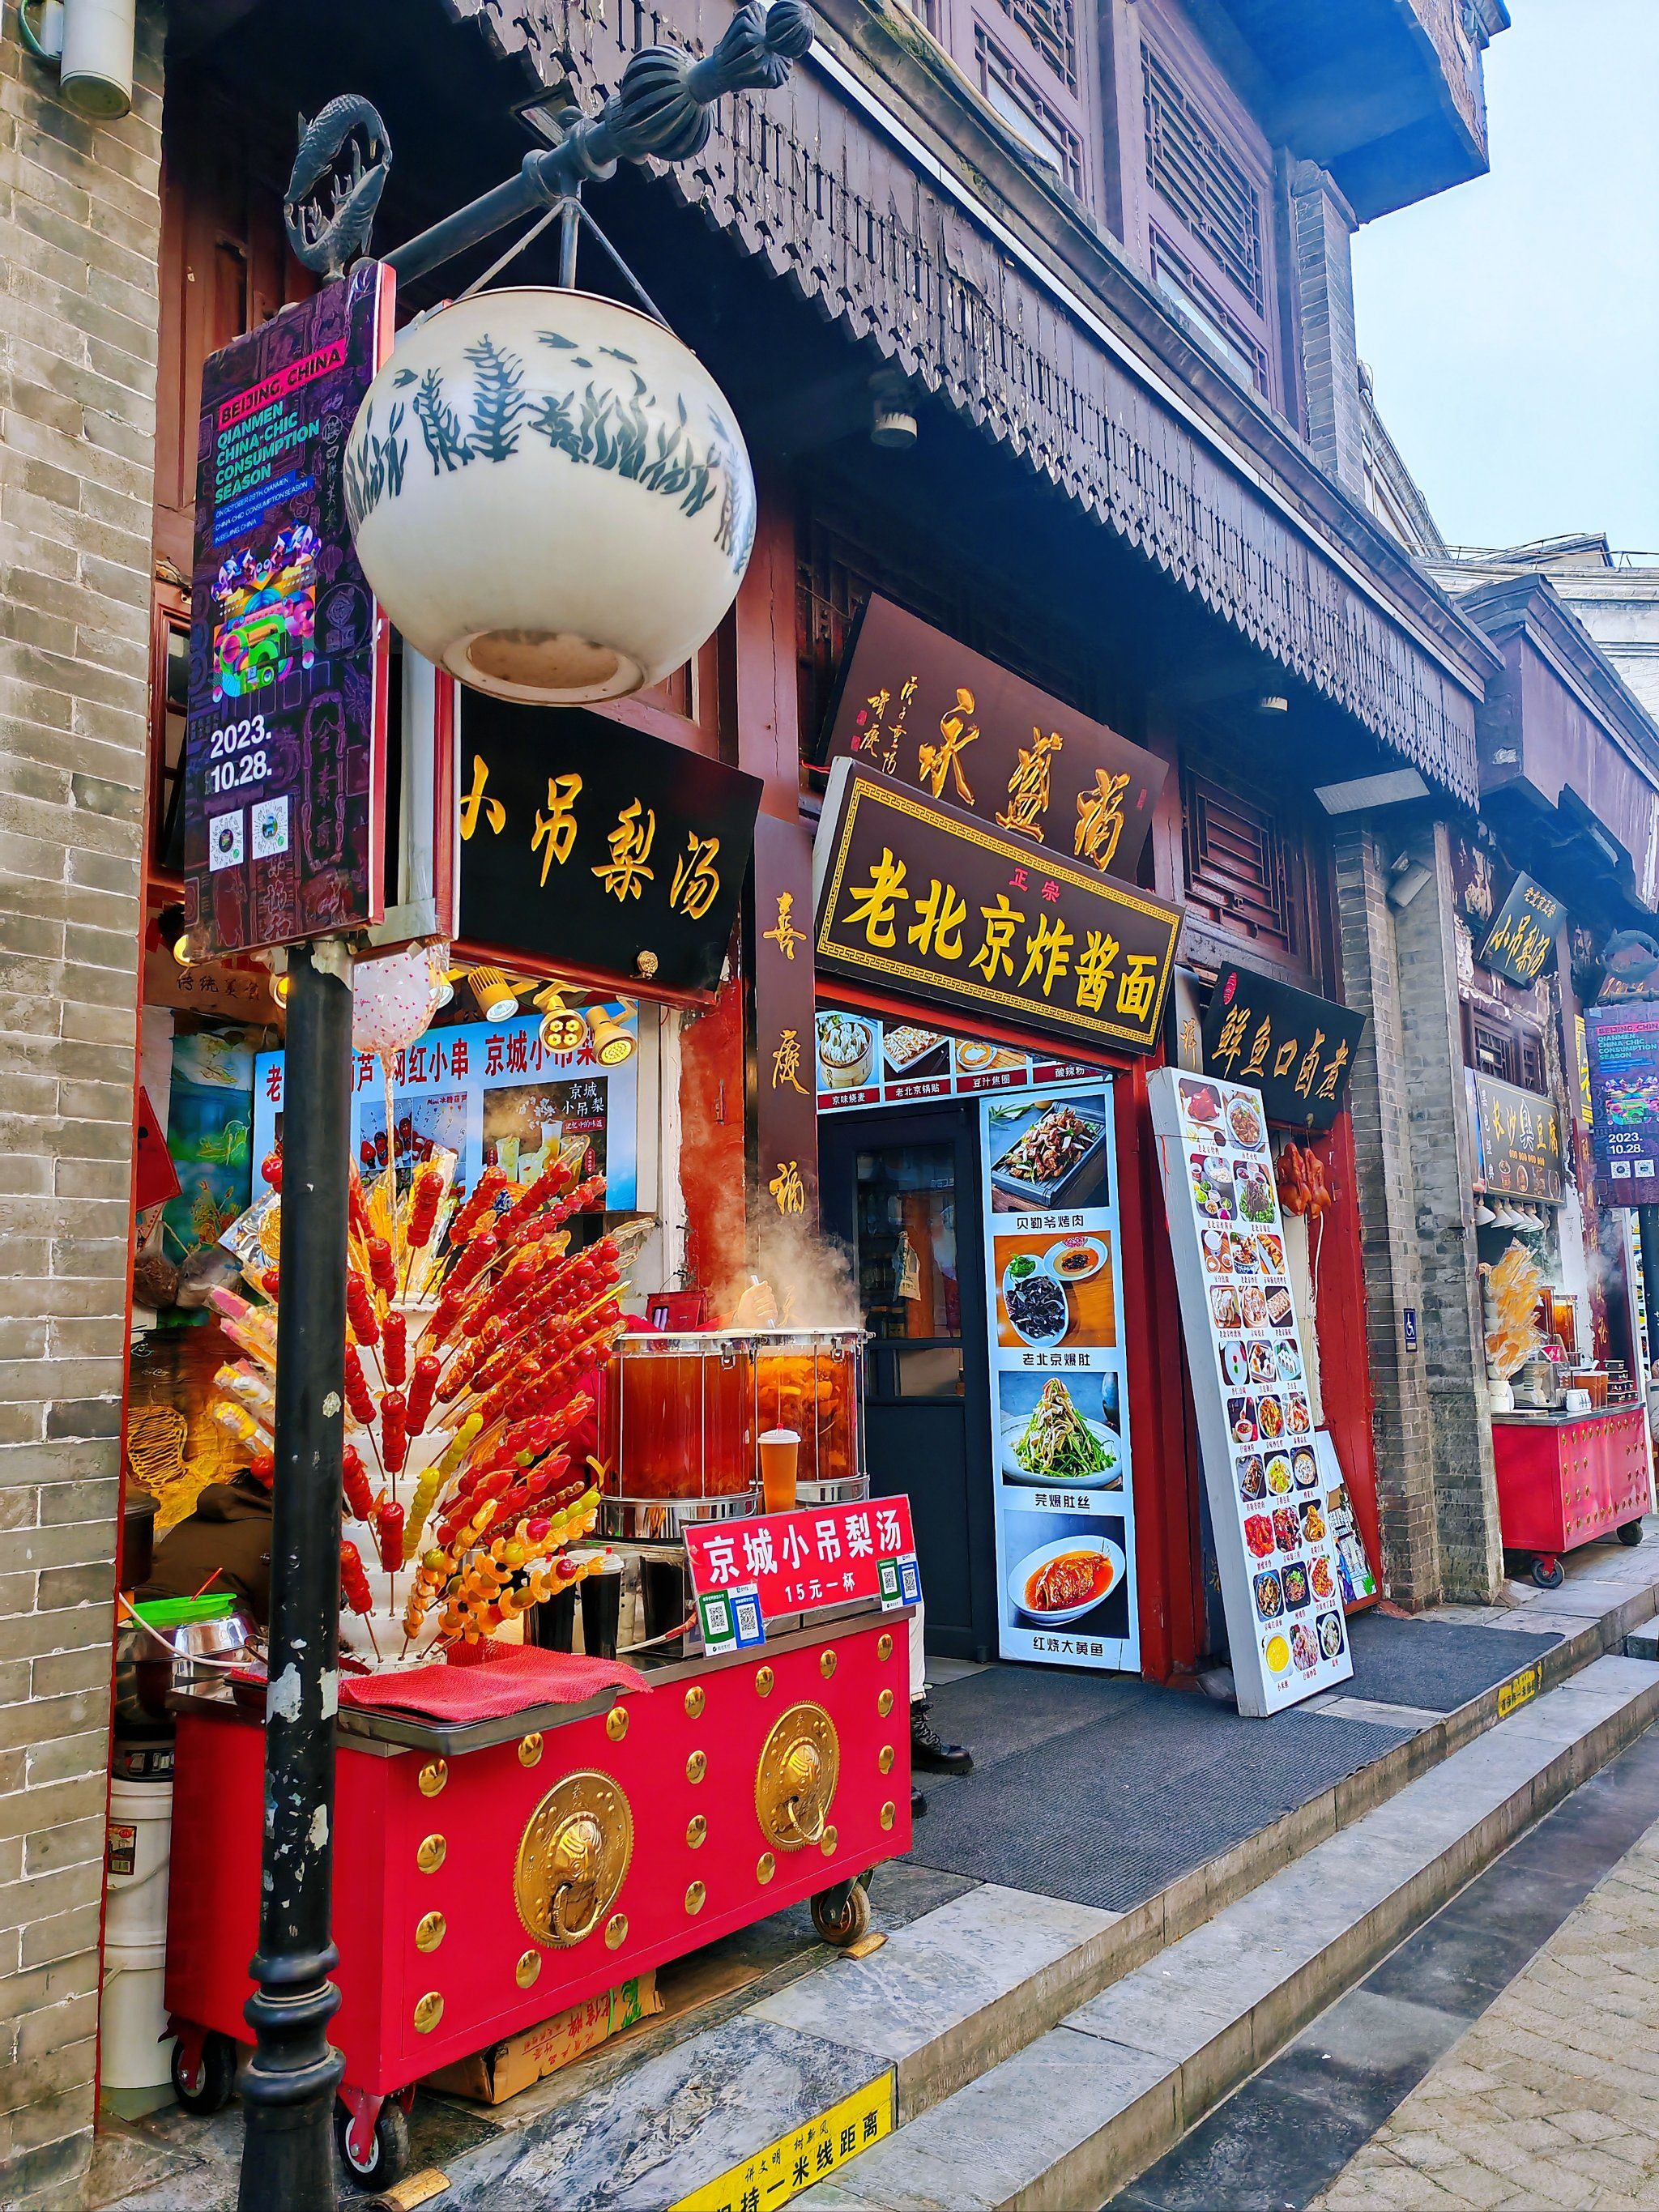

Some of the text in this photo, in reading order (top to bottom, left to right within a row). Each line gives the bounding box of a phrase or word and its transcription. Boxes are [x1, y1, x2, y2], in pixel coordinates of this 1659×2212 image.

[287, 348, 341, 386] CHINA
[216, 411, 298, 467] CHINA-CHIC
[217, 400, 284, 450] QIANMEN
[215, 418, 320, 486] CONSUMPTION
[215, 462, 271, 505] SEASON
[211, 714, 271, 759] 2023.
[211, 754, 272, 794] 10.28.
[459, 754, 720, 920] 小吊梨汤
[1009, 867, 1060, 903] 正宗
[842, 847, 1158, 1023] 老北京炸酱面
[1490, 914, 1550, 978] 小吊梨汤
[1211, 1003, 1349, 1100] 鲜鱼口卤煮
[1597, 1033, 1636, 1043] QIANMEN
[1597, 1038, 1645, 1048] CHINA-CHIC
[1598, 1043, 1657, 1055] CONSUMPTION
[1055, 1066, 1085, 1078] 酸辣粉
[1598, 1052, 1632, 1060] SEASON
[266, 1063, 283, 1102] 老
[569, 1081, 598, 1100] 京城
[895, 1083, 940, 1097] 老北京锅贴
[972, 1074, 1011, 1089] 豆汁焦圈
[562, 1097, 605, 1117] 小吊梨
[832, 1092, 866, 1106] 京味烧麦
[1492, 1095, 1559, 1158] 长沙臭豆腐
[1608, 1132, 1644, 1144] 2023.
[1610, 1144, 1644, 1155] 10.28.
[1016, 1214, 1084, 1230] 贝勒爷烤肉
[1022, 1352, 1091, 1367] 老北京爆肚
[1034, 1494, 1090, 1511] 芫爆肚丝
[702, 1508, 902, 1584] 京城小吊梨汤
[784, 1571, 856, 1603] 15元一杯
[1032, 1636, 1104, 1657] 红烧大黄鱼
[744, 2119, 829, 2183] 讲文明 树新风
